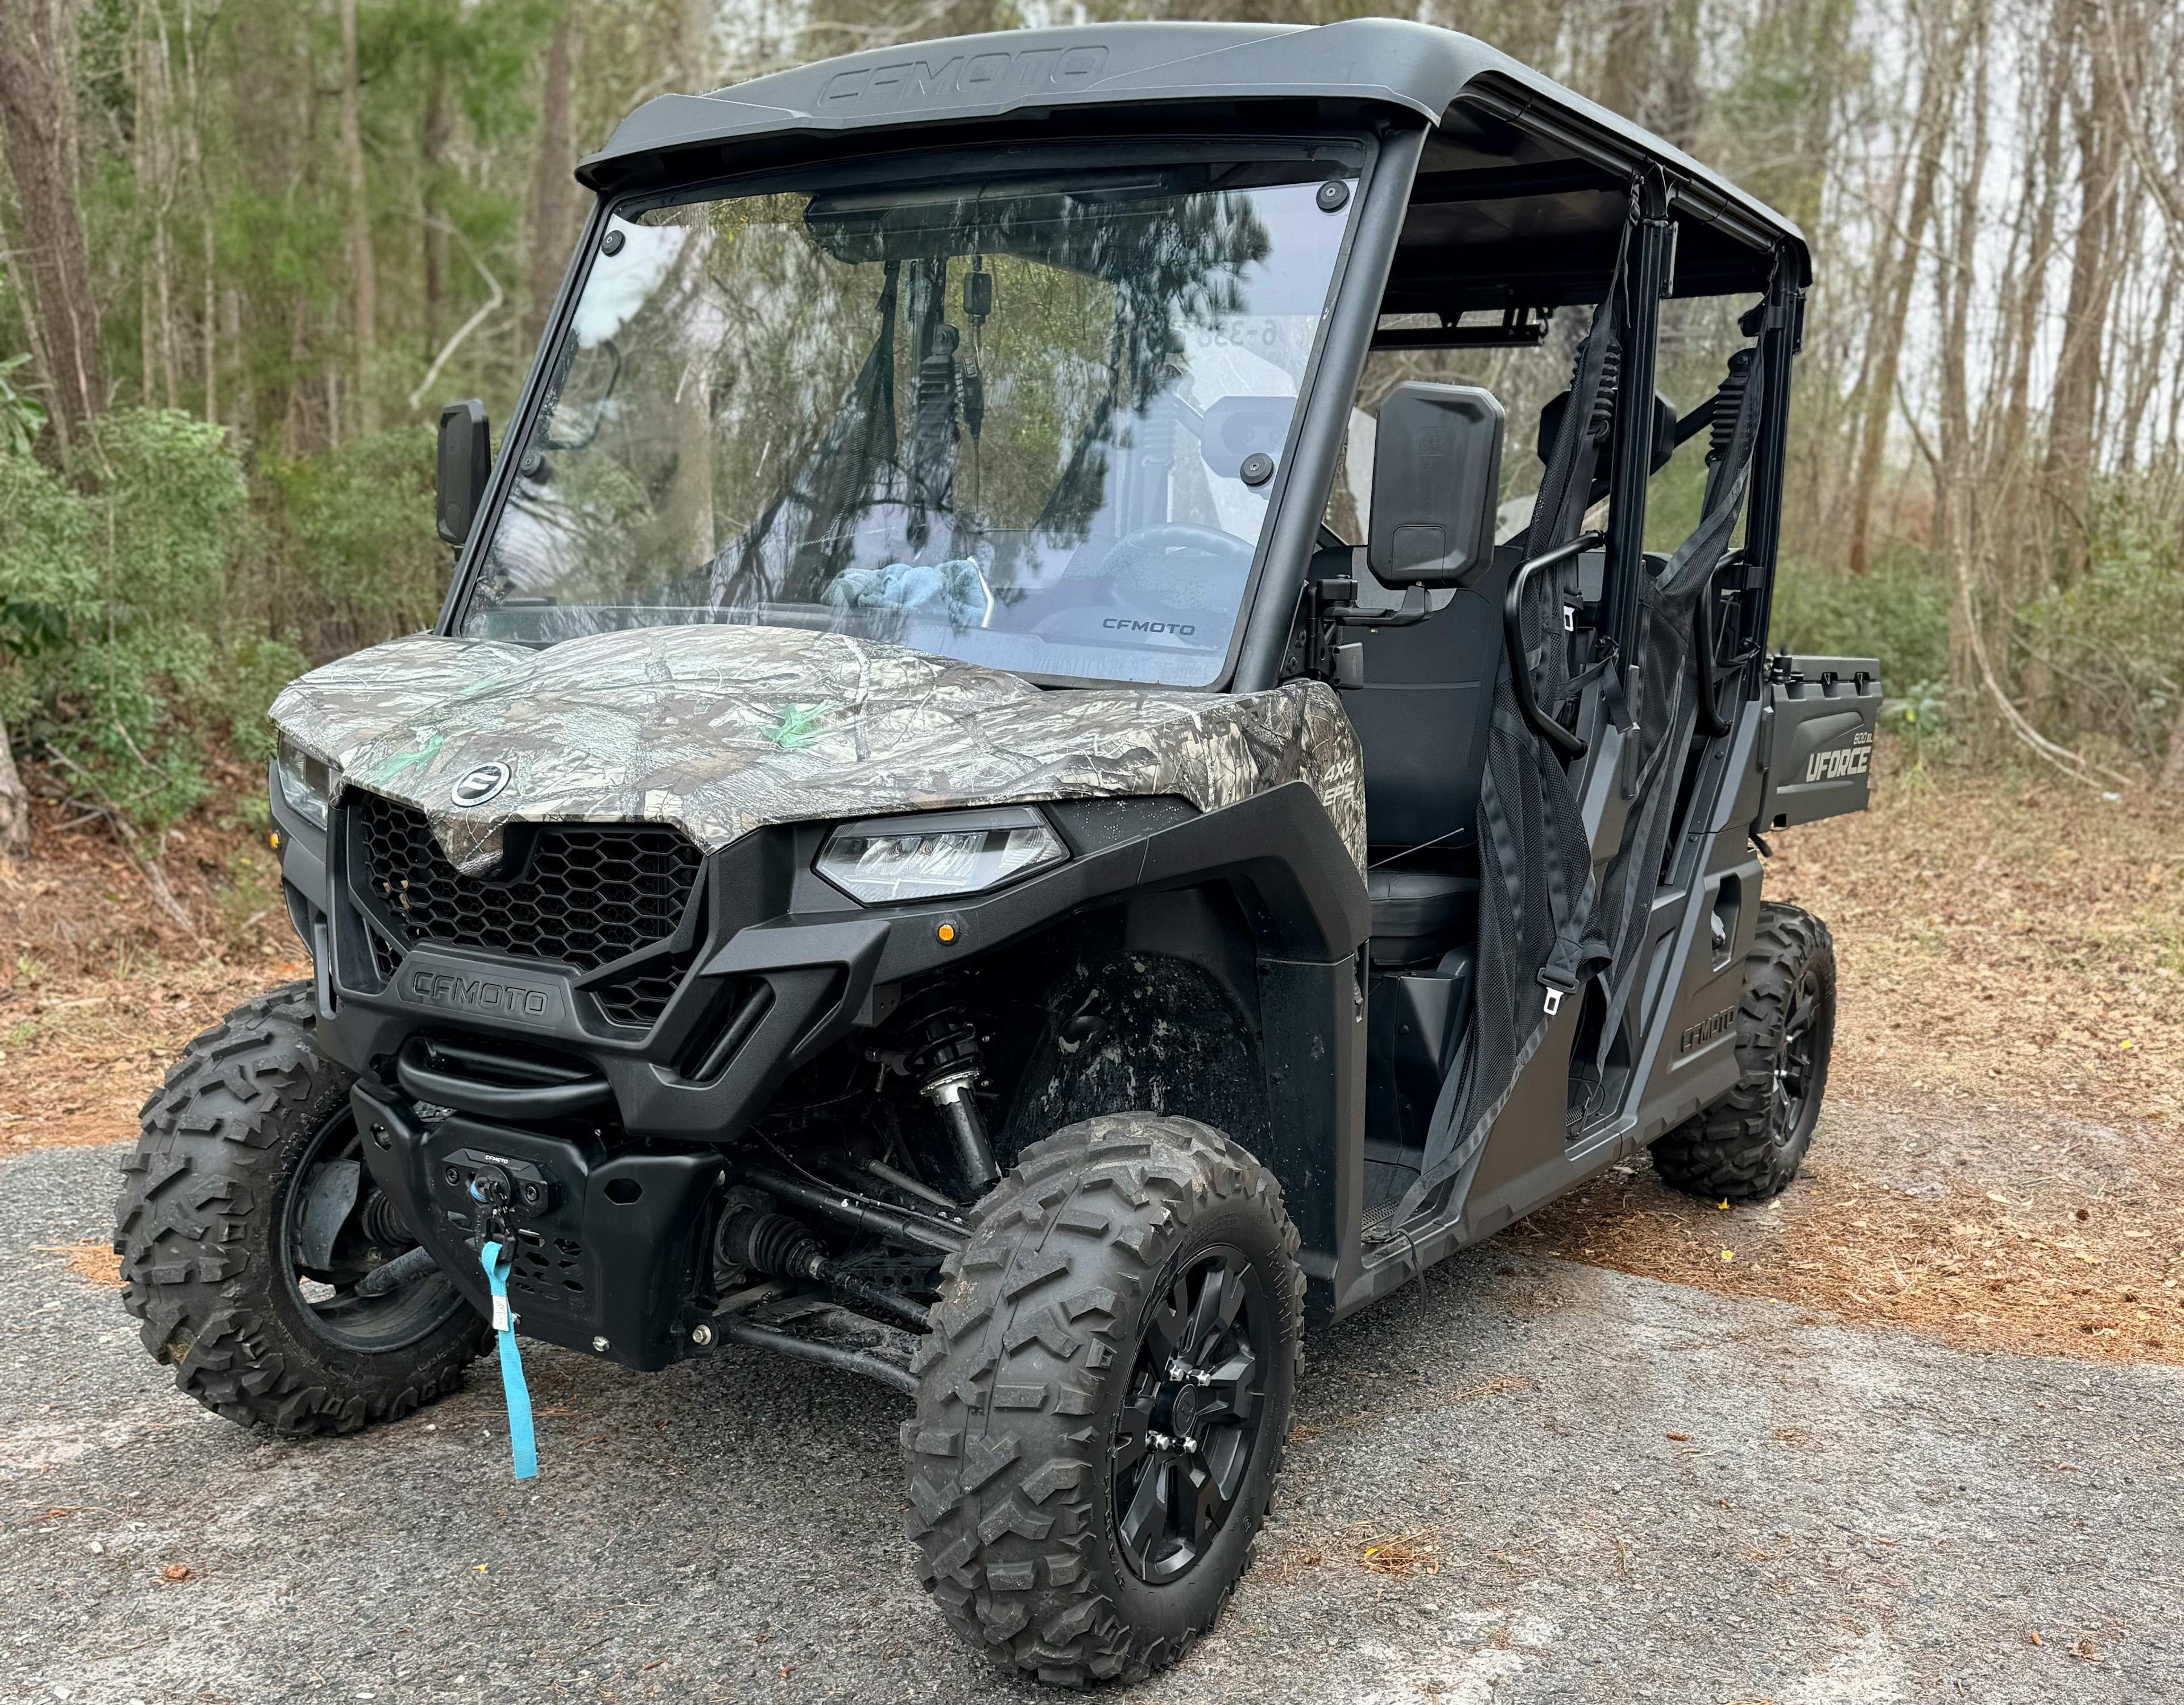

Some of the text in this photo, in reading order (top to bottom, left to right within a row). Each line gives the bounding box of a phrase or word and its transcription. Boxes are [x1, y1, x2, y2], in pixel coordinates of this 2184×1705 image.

[817, 45, 1110, 109] CFMOTO
[1102, 618, 1196, 635] CFMOTO
[1806, 746, 1872, 783] UFORCE
[1323, 781, 1355, 807] EPS
[412, 971, 548, 1016] CFMOTO
[1681, 1005, 1735, 1052] CFMOTO
